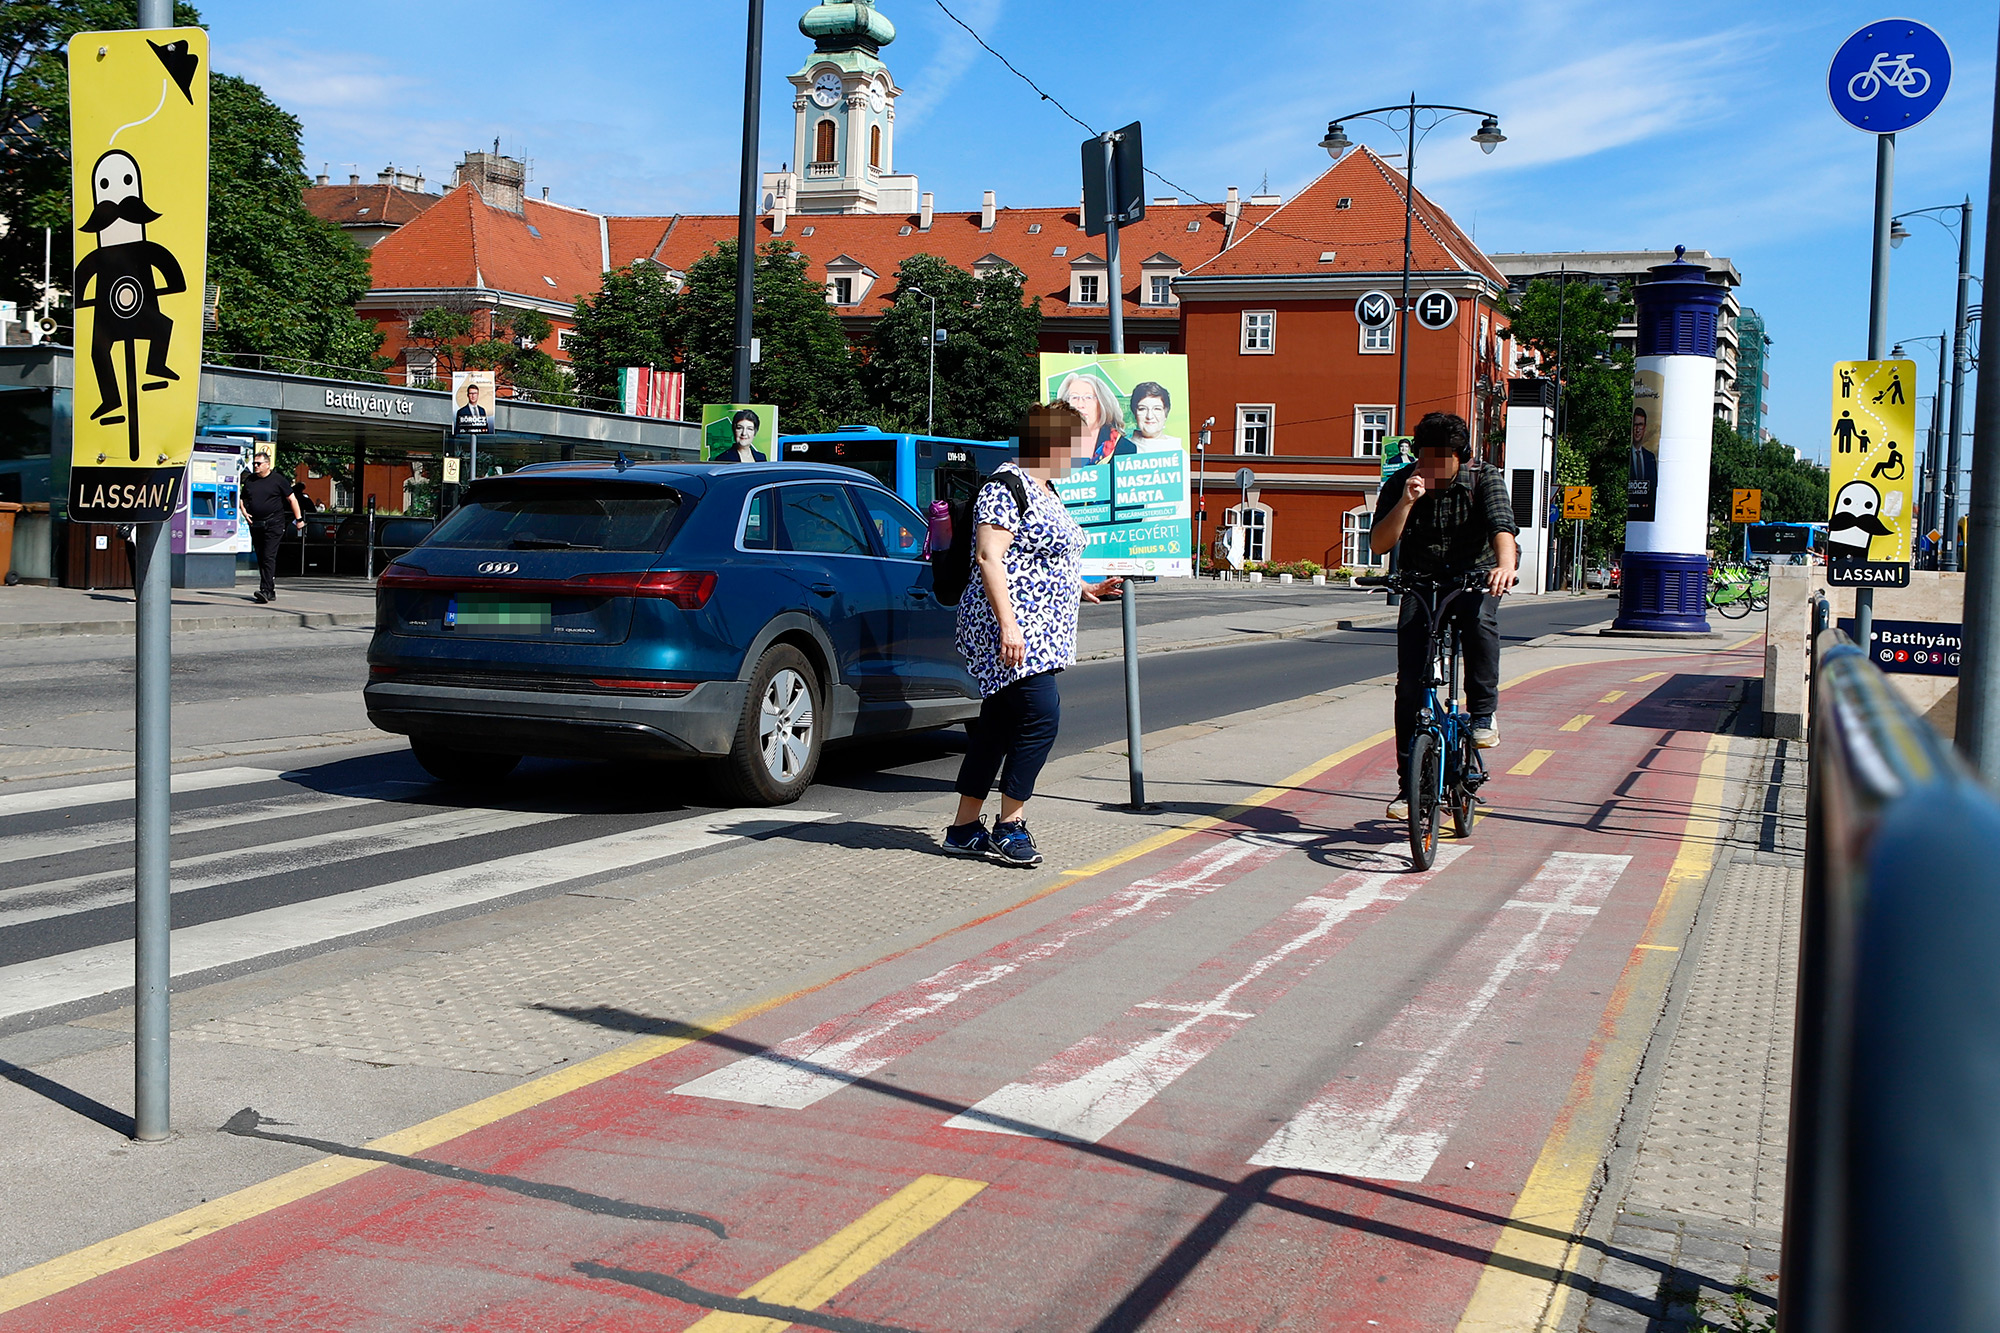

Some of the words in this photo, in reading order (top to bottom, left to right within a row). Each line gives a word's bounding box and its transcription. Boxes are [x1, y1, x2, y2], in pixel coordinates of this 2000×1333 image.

[1426, 298, 1445, 320] H
[325, 389, 393, 416] Batthyány
[395, 396, 414, 414] tér
[1116, 454, 1180, 472] VÁRADINÉ
[1117, 470, 1182, 489] NASZÁLYI
[79, 477, 175, 512] LASSAN!
[1117, 488, 1165, 505] MÁRTA
[1109, 530, 1127, 544] AZ
[1129, 524, 1180, 542] EGYÉRT!
[1129, 545, 1158, 556] JÚNIUS
[1158, 545, 1167, 553] 9.
[1833, 566, 1903, 584] LASSAN!
[1881, 630, 1962, 651] Batthyány
[1897, 652, 1905, 661] 2
[1932, 654, 1939, 662] 5
